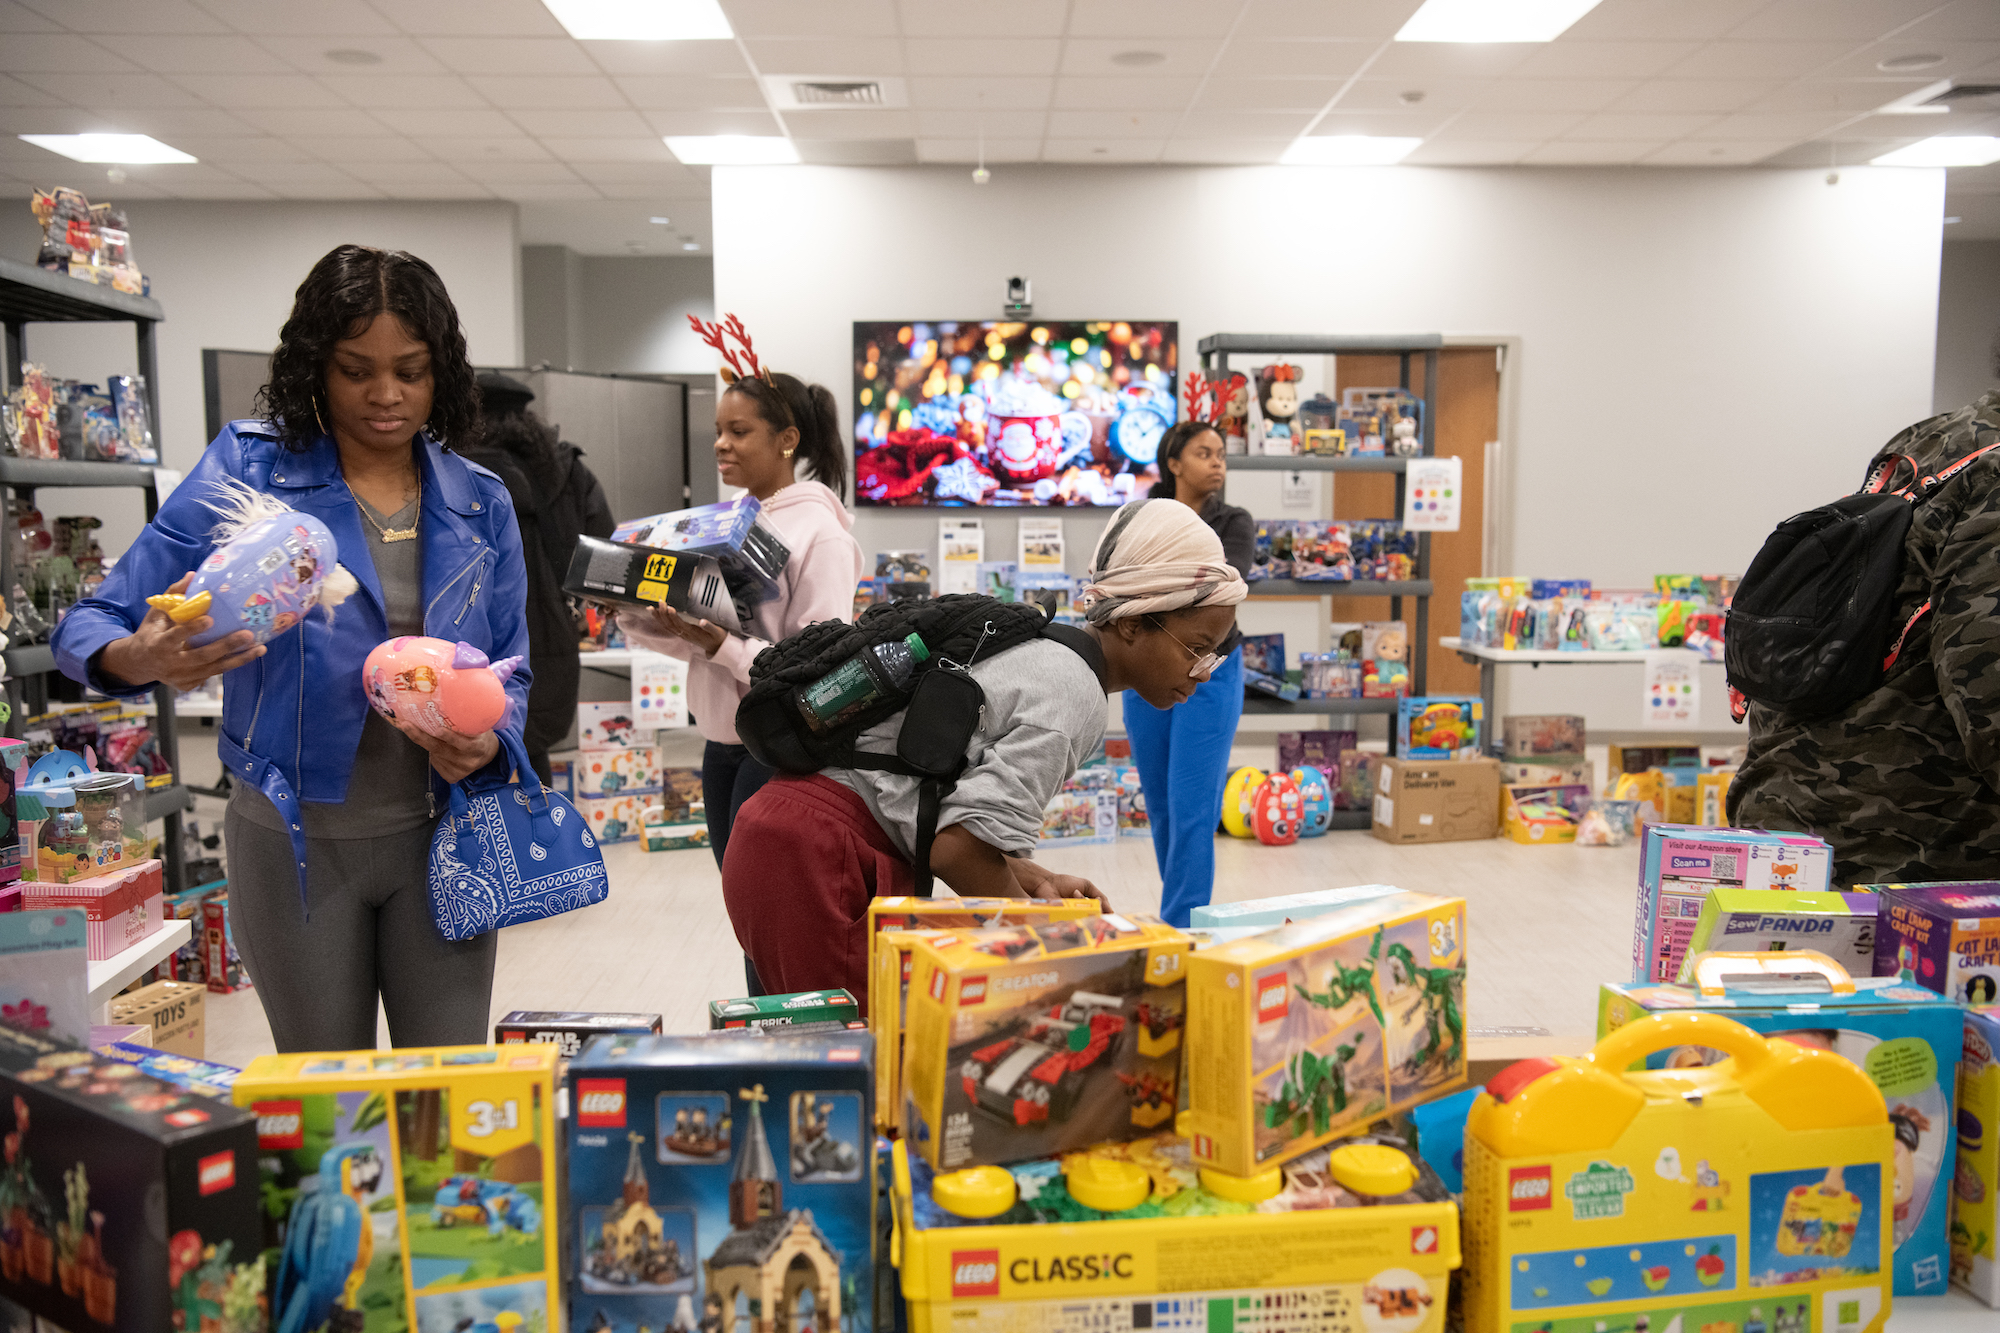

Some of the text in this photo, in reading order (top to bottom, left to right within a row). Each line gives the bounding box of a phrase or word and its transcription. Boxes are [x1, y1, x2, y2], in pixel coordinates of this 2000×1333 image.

[1669, 841, 1684, 849] Visit
[1697, 843, 1724, 852] Amazon
[1673, 858, 1694, 867] Scan
[1729, 917, 1835, 933] Sew PANDA
[1891, 906, 1933, 931] CAT LAMP
[1891, 919, 1930, 945] CRAFT KIT
[1956, 939, 1981, 954] CAT
[1958, 954, 1995, 969] CRAFT
[961, 972, 1059, 998] LEGO CREATOR
[153, 1001, 185, 1029] TOYS
[762, 1016, 793, 1027] BRICK
[530, 1032, 580, 1045] STAR
[581, 1093, 623, 1113] LEGO
[1512, 1179, 1550, 1199] LEGO
[955, 1263, 996, 1285] LEGO
